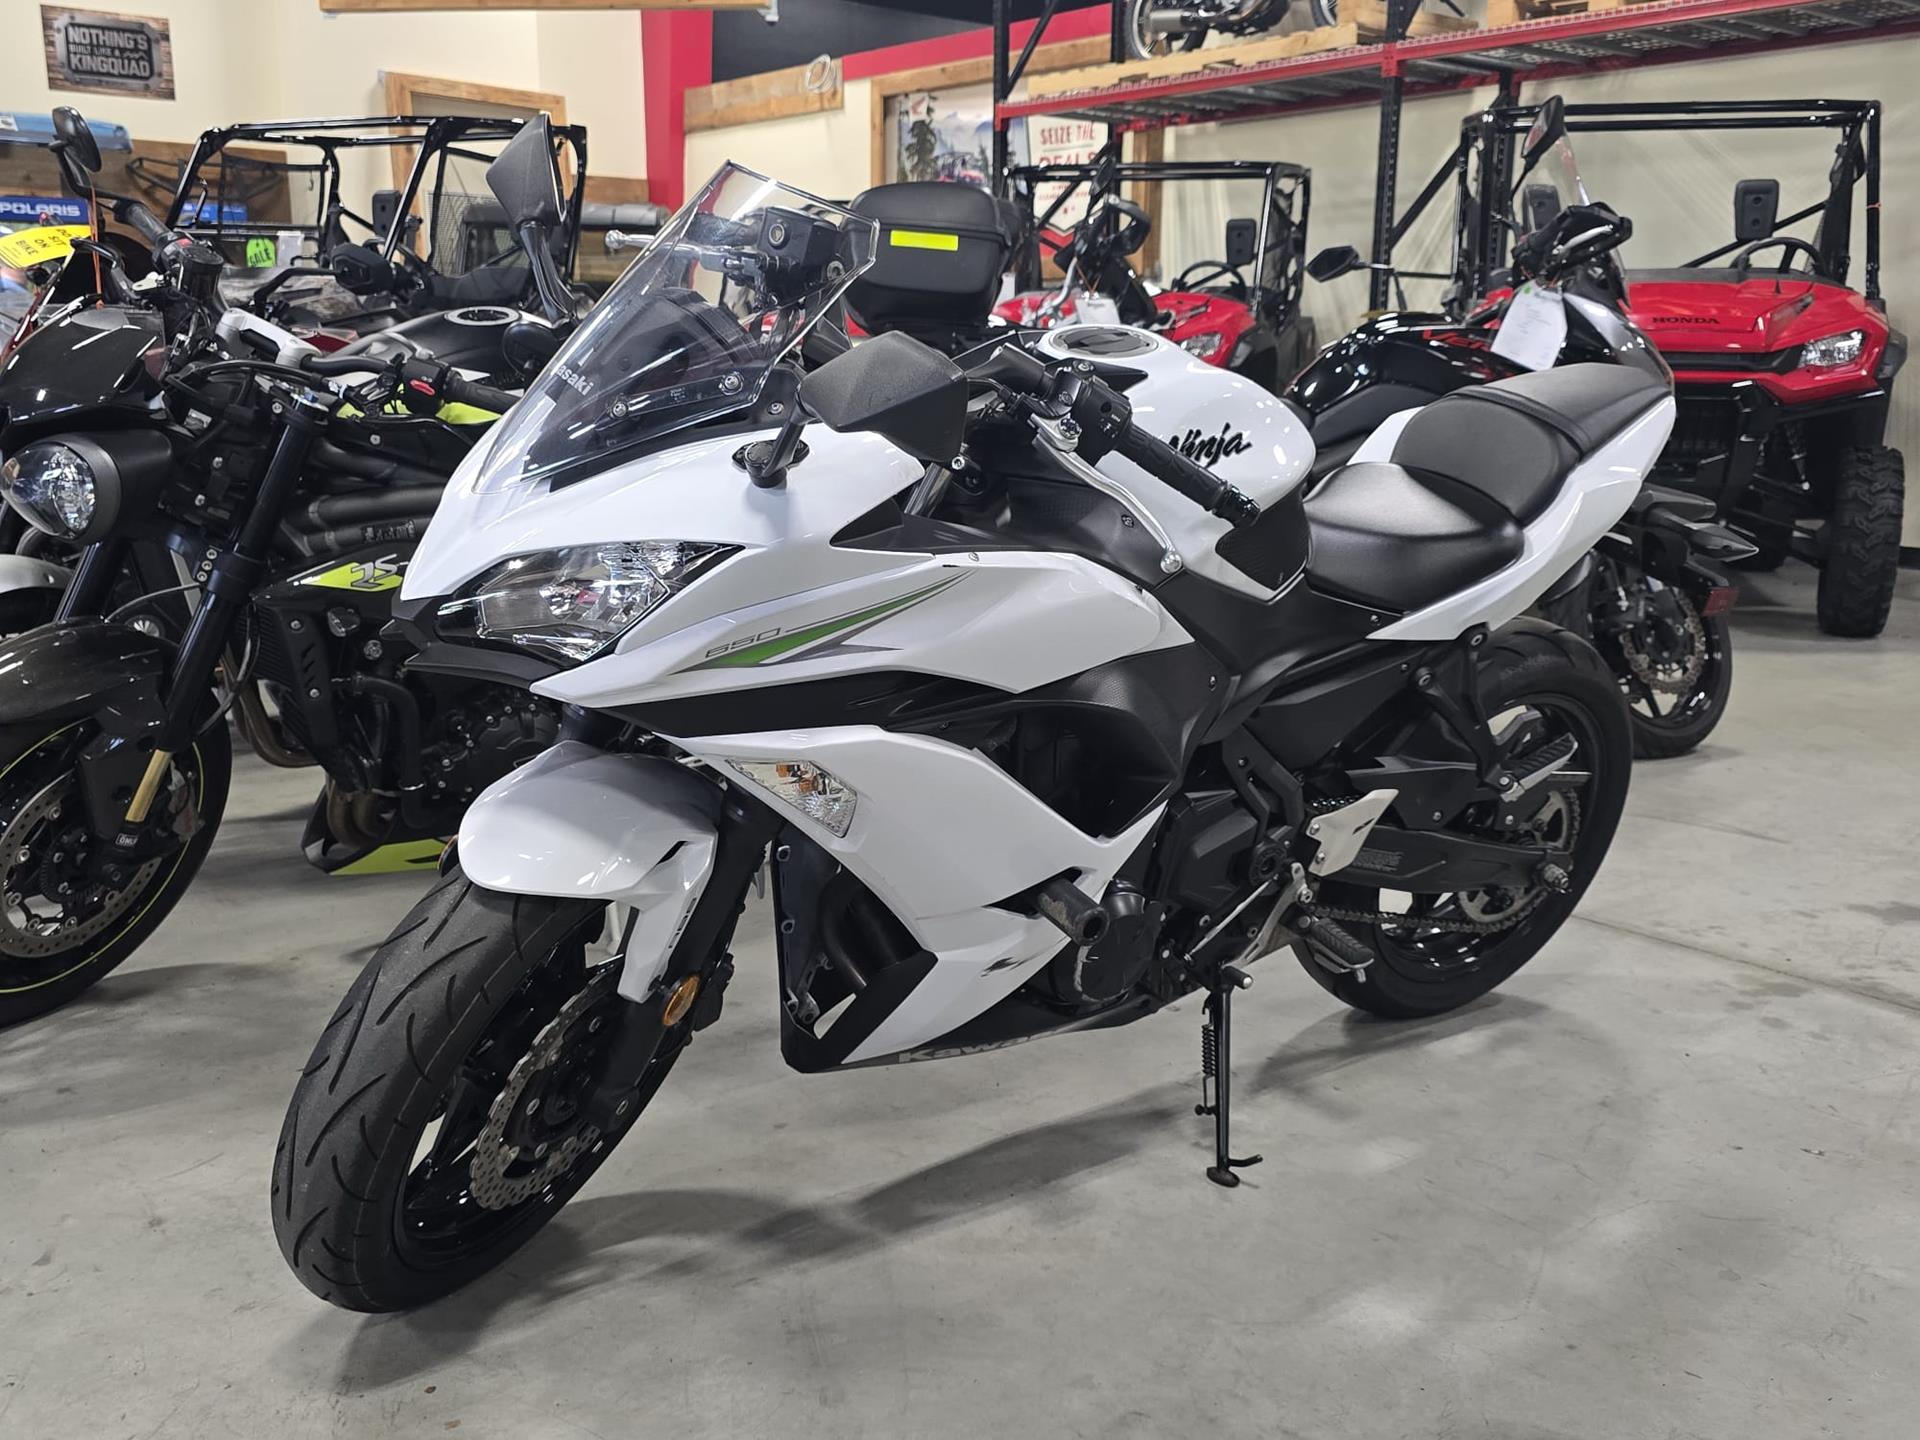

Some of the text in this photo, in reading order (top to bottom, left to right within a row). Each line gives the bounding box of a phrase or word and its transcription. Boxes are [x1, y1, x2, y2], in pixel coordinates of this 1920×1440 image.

[67, 26, 149, 51] NOTHING'S
[70, 53, 152, 78] KINGQUAD
[1041, 122, 1095, 145] SEIZE THE
[0, 201, 81, 217] POLARIS
[1652, 316, 1720, 325] HONDA
[704, 627, 782, 659] 650
